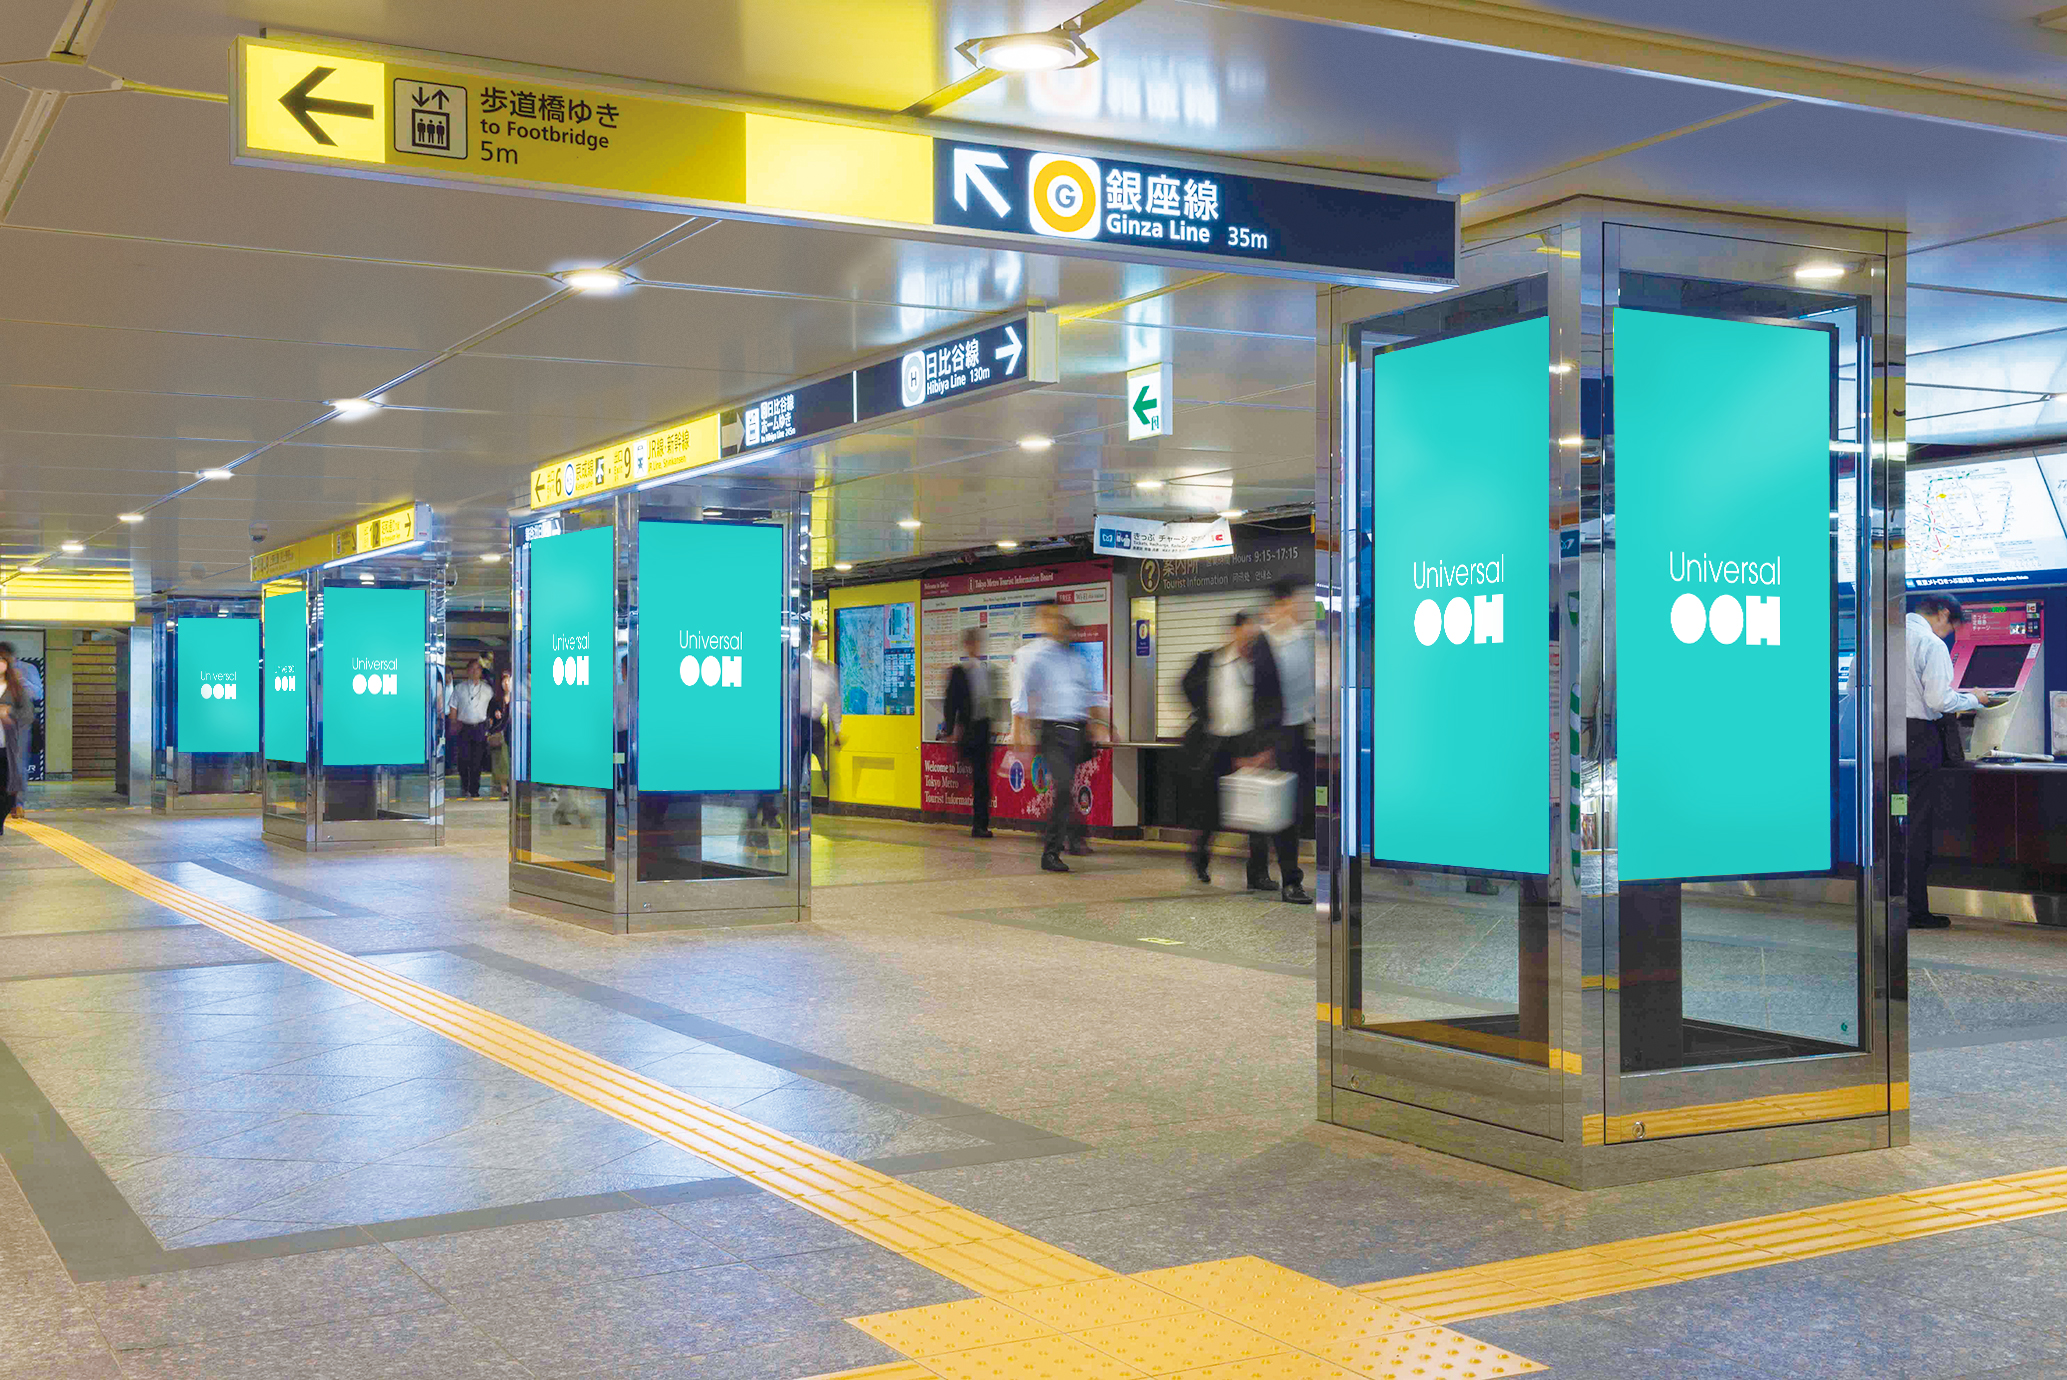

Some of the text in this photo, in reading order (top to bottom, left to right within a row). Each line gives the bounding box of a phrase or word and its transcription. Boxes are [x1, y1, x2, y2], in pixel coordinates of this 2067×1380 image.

[480, 86, 619, 129] 歩道橋ゆき
[480, 119, 609, 151] to Footbridge
[480, 140, 518, 165] 5m
[1055, 183, 1076, 209] G
[1106, 168, 1219, 221] 銀座線
[1106, 213, 1268, 249] Ginza Line 35m
[926, 338, 979, 380] 日比谷線
[910, 370, 917, 388] H
[926, 366, 990, 395] Hibiya Line 130m
[624, 447, 631, 478] 9
[555, 468, 562, 496] 6
[1133, 532, 1155, 542] きっぷ
[1159, 534, 1188, 543] チャージ
[1232, 552, 1252, 564] Hours
[1670, 551, 1780, 585] Universal
[1163, 579, 1187, 590] Tourist
[1187, 574, 1229, 588] Information
[1414, 554, 1503, 589] Universal
[1414, 594, 1503, 646] OOH
[1671, 593, 1780, 645] OOH
[553, 632, 589, 651] Universal
[680, 630, 742, 649] Universal
[353, 658, 397, 670] Universal
[553, 656, 589, 685] OOH
[680, 655, 742, 687] OOH
[201, 684, 236, 699] OOH
[275, 676, 295, 691] OOH
[353, 674, 397, 695] OOH
[924, 760, 949, 773] Welcome
[924, 775, 959, 790] Tokyo Metro
[924, 790, 944, 804] Tourist
